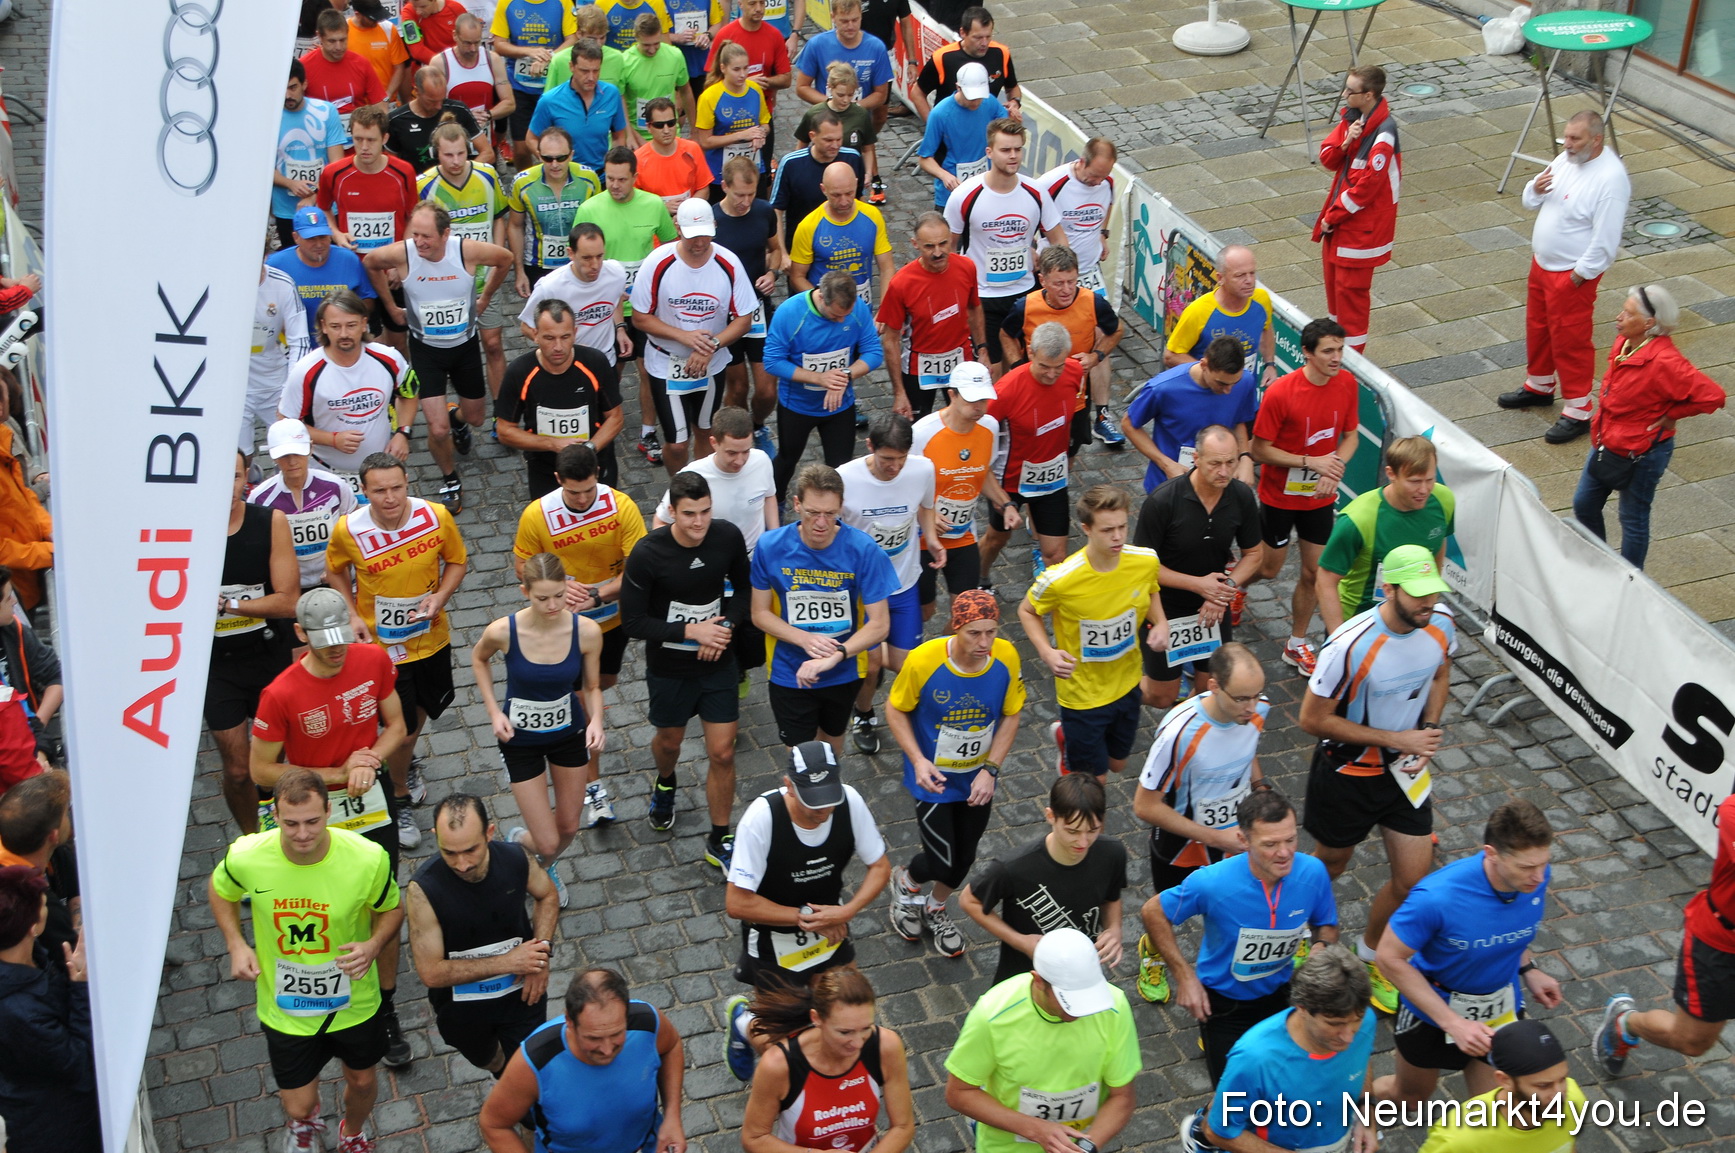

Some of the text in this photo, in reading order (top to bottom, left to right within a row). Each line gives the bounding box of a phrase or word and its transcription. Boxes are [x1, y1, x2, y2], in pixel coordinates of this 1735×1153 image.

[450, 202, 488, 219] BOCK
[538, 200, 580, 212] BOCK
[1062, 208, 1099, 216] GERHART
[353, 222, 390, 238] 2342
[982, 220, 1022, 228] GERHART
[990, 255, 1024, 272] 3359
[426, 308, 462, 326] 2057
[584, 310, 610, 321] JANIG
[924, 356, 958, 374] 2181
[328, 393, 374, 407] GERHART
[350, 399, 380, 412] JANIG
[550, 418, 580, 434] 169
[940, 465, 985, 476] SportScheck
[1026, 464, 1064, 483] 2452
[122, 282, 210, 749] Audi BKK
[294, 523, 328, 544] 560
[553, 520, 621, 550] MAX BÖGL
[366, 535, 443, 575] MAX BÖGL
[781, 568, 855, 580] 10. NEUMARKTER
[792, 576, 844, 588] STADTLAUF
[796, 602, 845, 620] 2695
[1087, 621, 1131, 646] 2149
[1170, 625, 1212, 648] 2381
[1546, 668, 1564, 688] die
[1565, 682, 1616, 738] verbinden
[516, 708, 566, 728] 3339
[956, 741, 981, 757] 49
[273, 898, 330, 912] Müller
[288, 924, 316, 944] M
[1473, 926, 1532, 948] ruhrgas
[1242, 938, 1299, 962] 2048
[277, 963, 336, 975] PARTL Neumarkt
[284, 973, 342, 996] 2557
[479, 982, 502, 992] Eyup
[294, 998, 334, 1008] Dominik
[1466, 1000, 1504, 1020] 341
[814, 1101, 866, 1122] Radsport
[1036, 1100, 1084, 1120] 317
